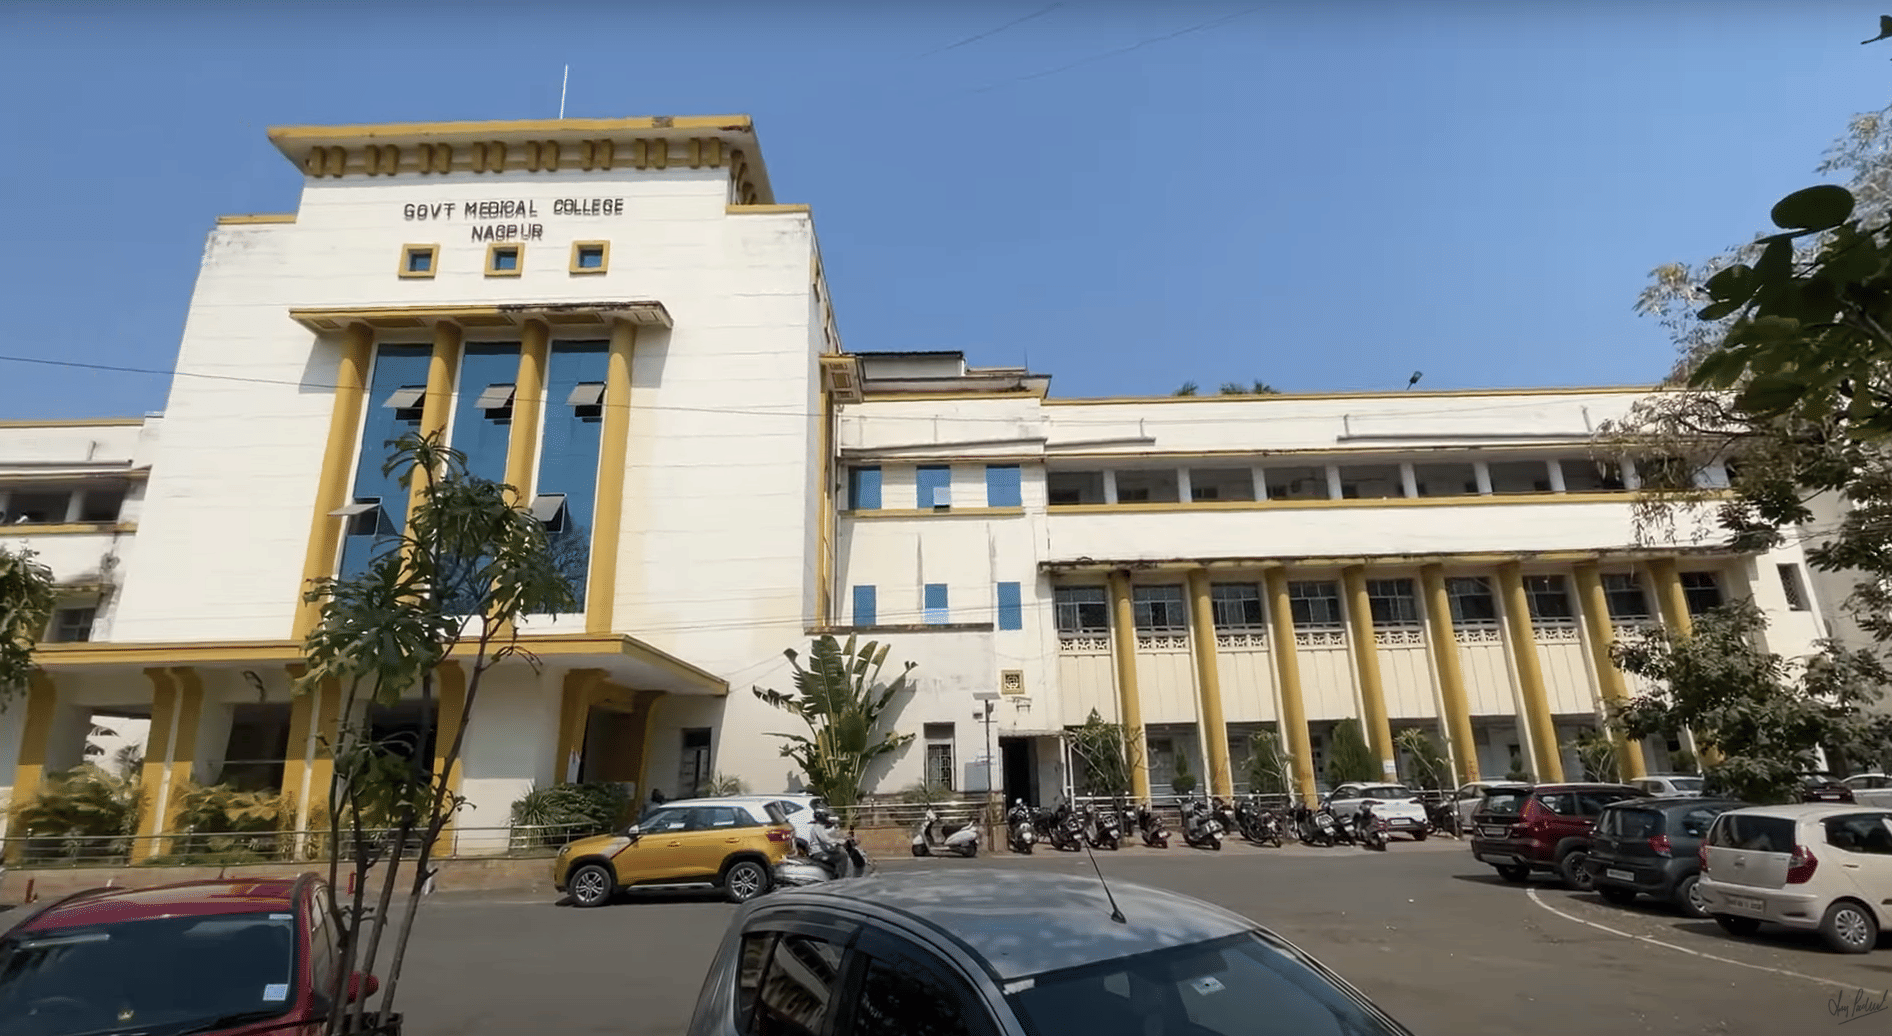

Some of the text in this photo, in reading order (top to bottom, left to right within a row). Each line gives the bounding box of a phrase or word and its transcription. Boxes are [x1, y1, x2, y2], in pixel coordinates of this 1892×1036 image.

[404, 198, 623, 220] GOVT MEDICAL COLLEGE
[471, 223, 543, 242] NAGPUR
